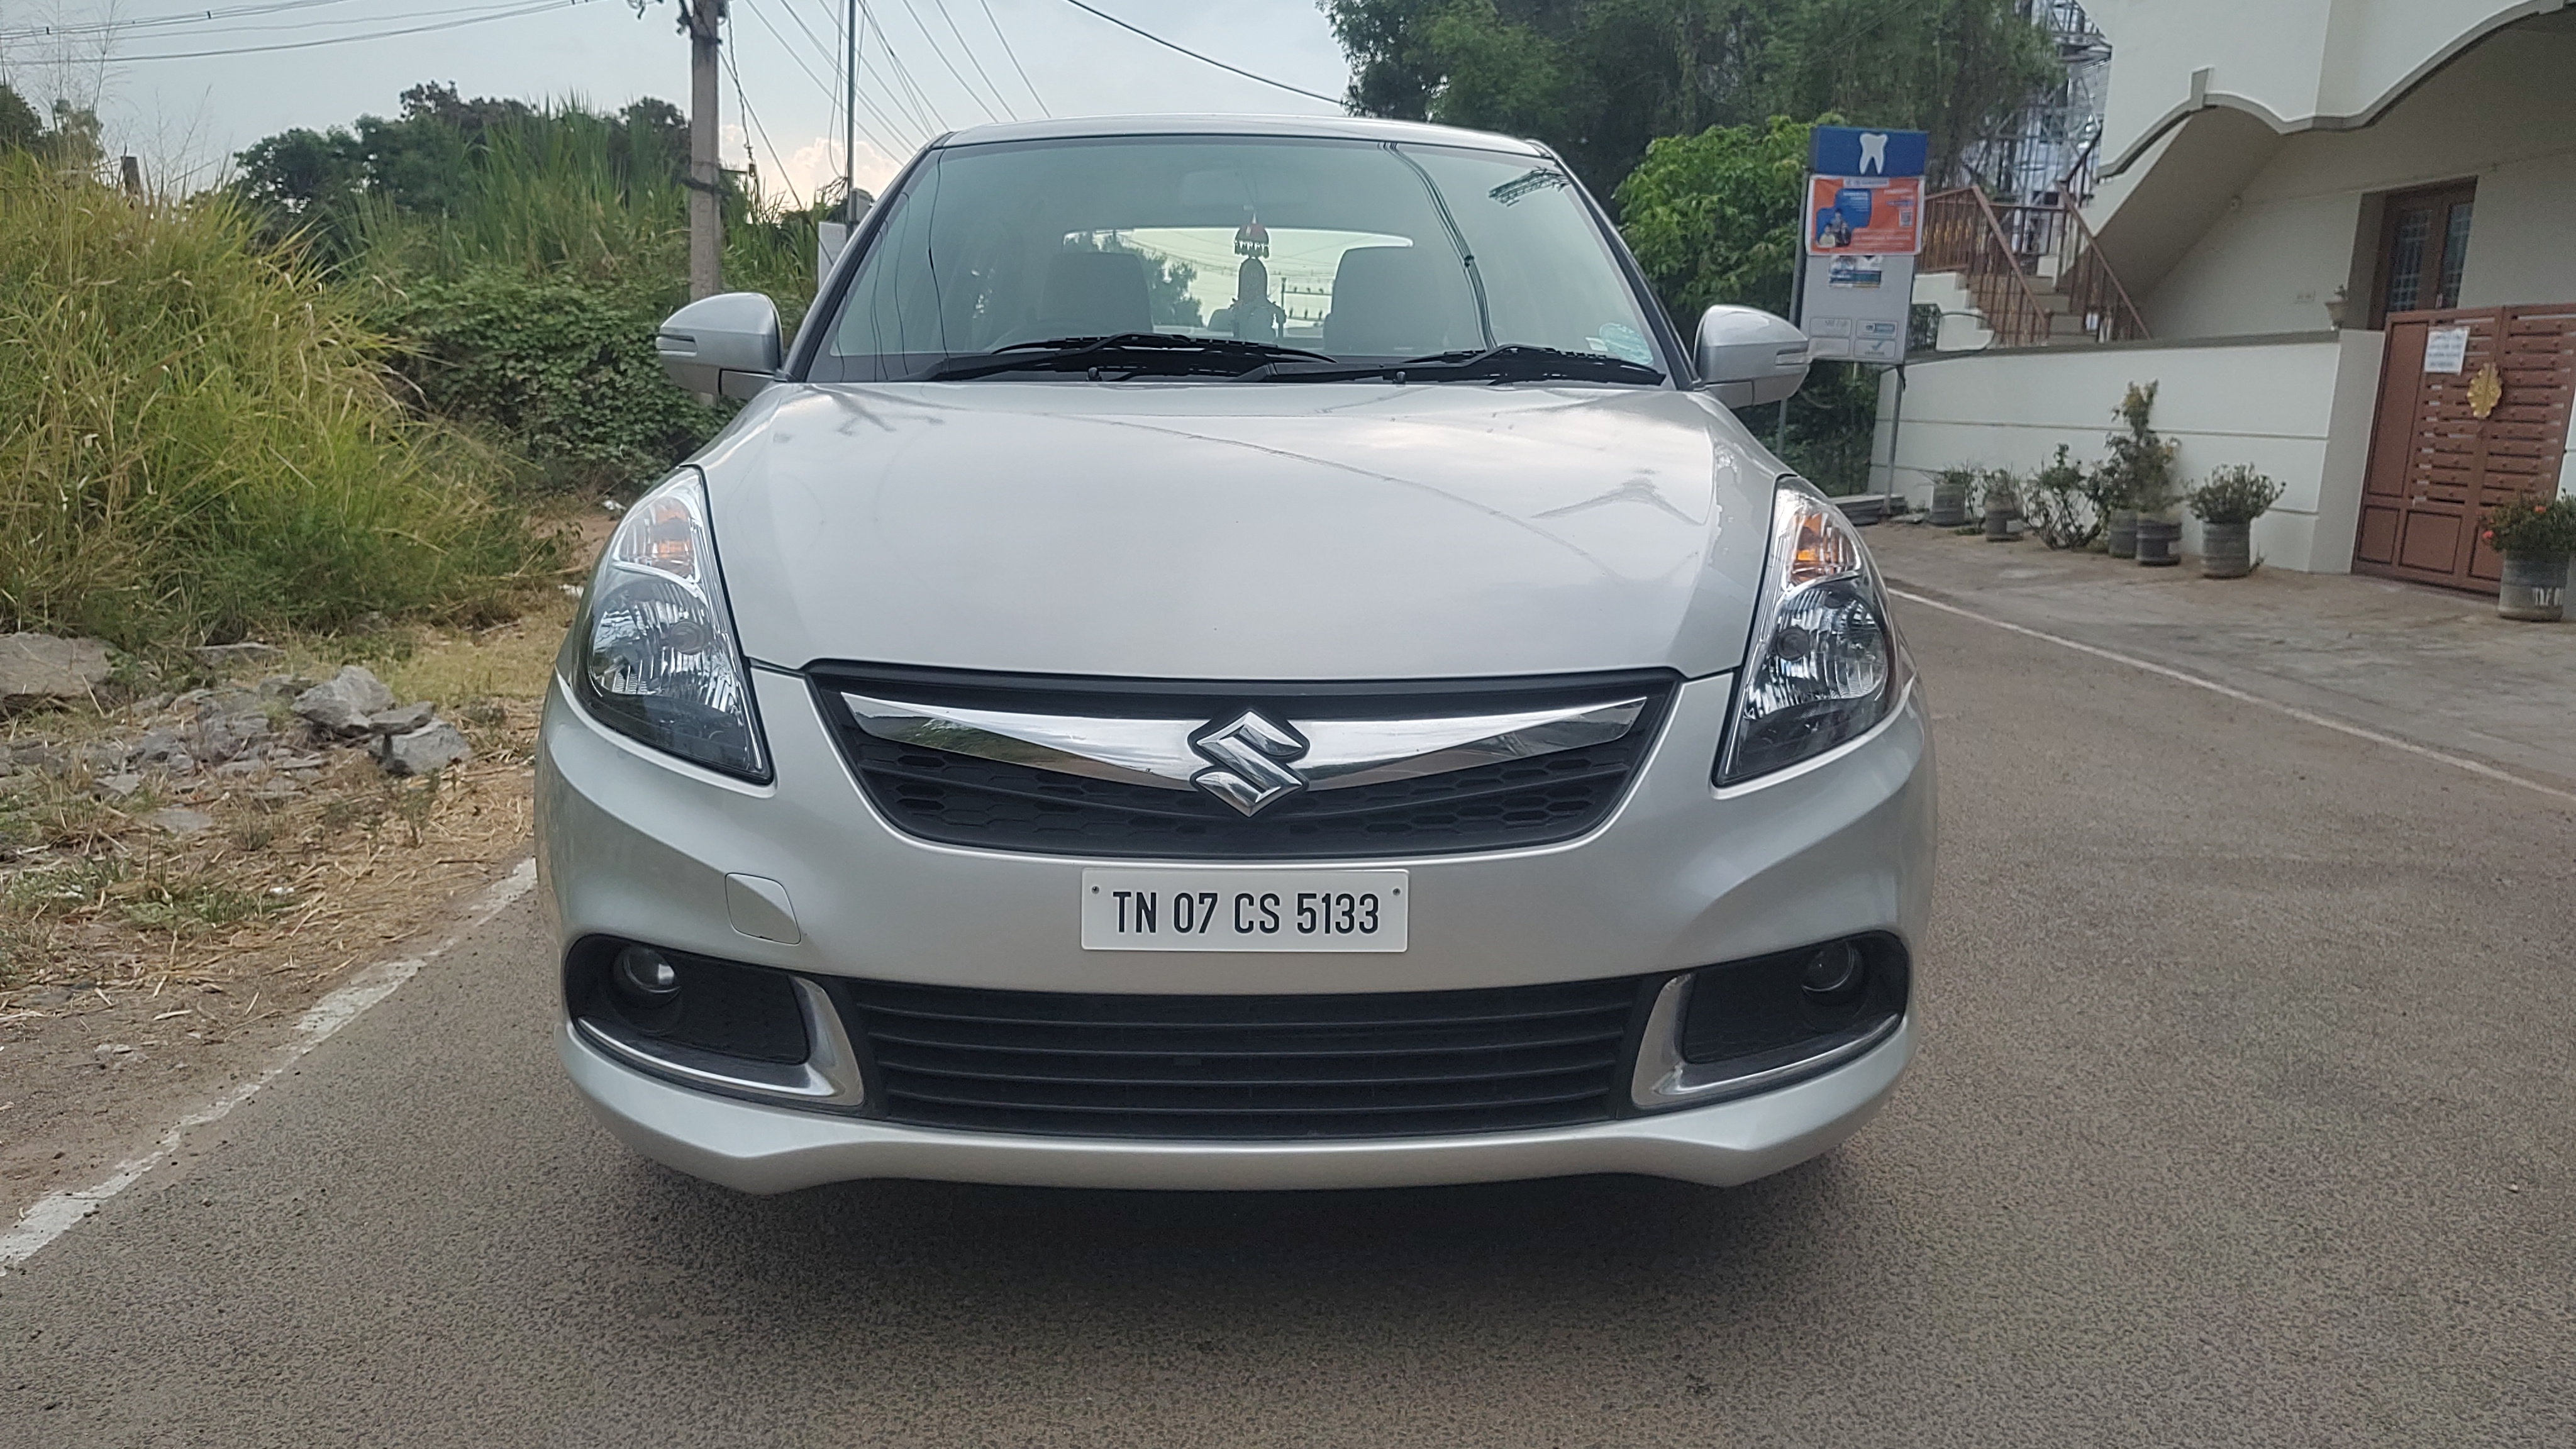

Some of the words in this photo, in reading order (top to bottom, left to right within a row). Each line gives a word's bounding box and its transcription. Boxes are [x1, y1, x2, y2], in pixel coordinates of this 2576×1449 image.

[1113, 891, 1157, 933] TN
[1174, 892, 1218, 934] 07
[1235, 893, 1280, 934] CS
[1297, 893, 1379, 935] 5133
